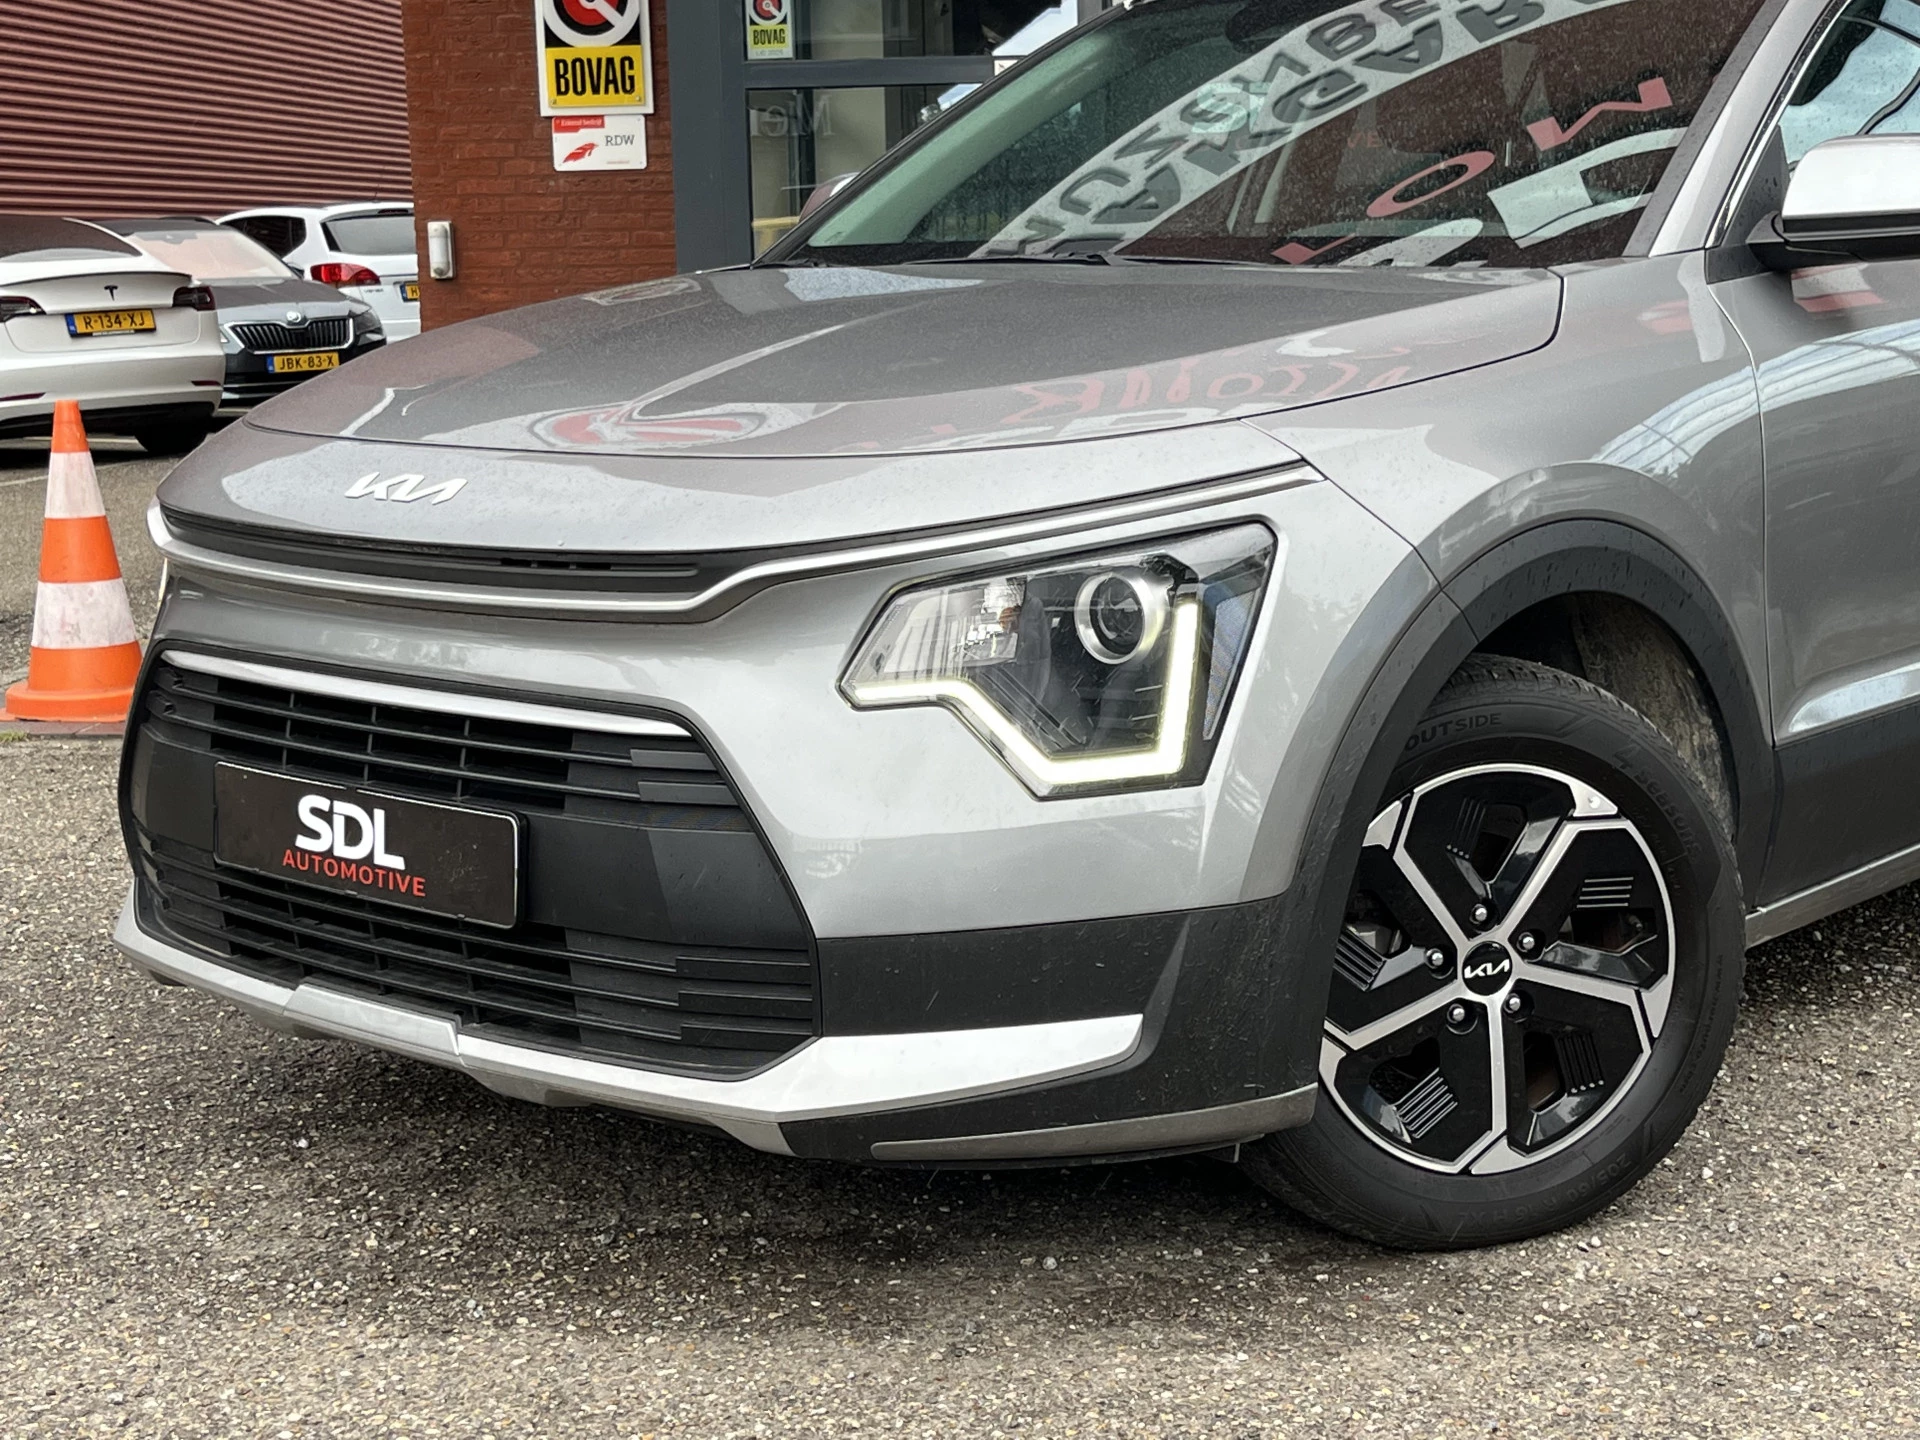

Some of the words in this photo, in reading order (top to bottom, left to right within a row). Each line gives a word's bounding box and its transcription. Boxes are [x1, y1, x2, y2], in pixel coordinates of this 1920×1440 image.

[753, 28, 786, 45] BOVAG
[554, 55, 635, 97] BOVAG
[605, 135, 635, 147] RDW
[1404, 712, 1503, 752] OUTSIDE
[294, 794, 406, 871] SDL
[282, 849, 426, 897] AUTOMOTIVE
